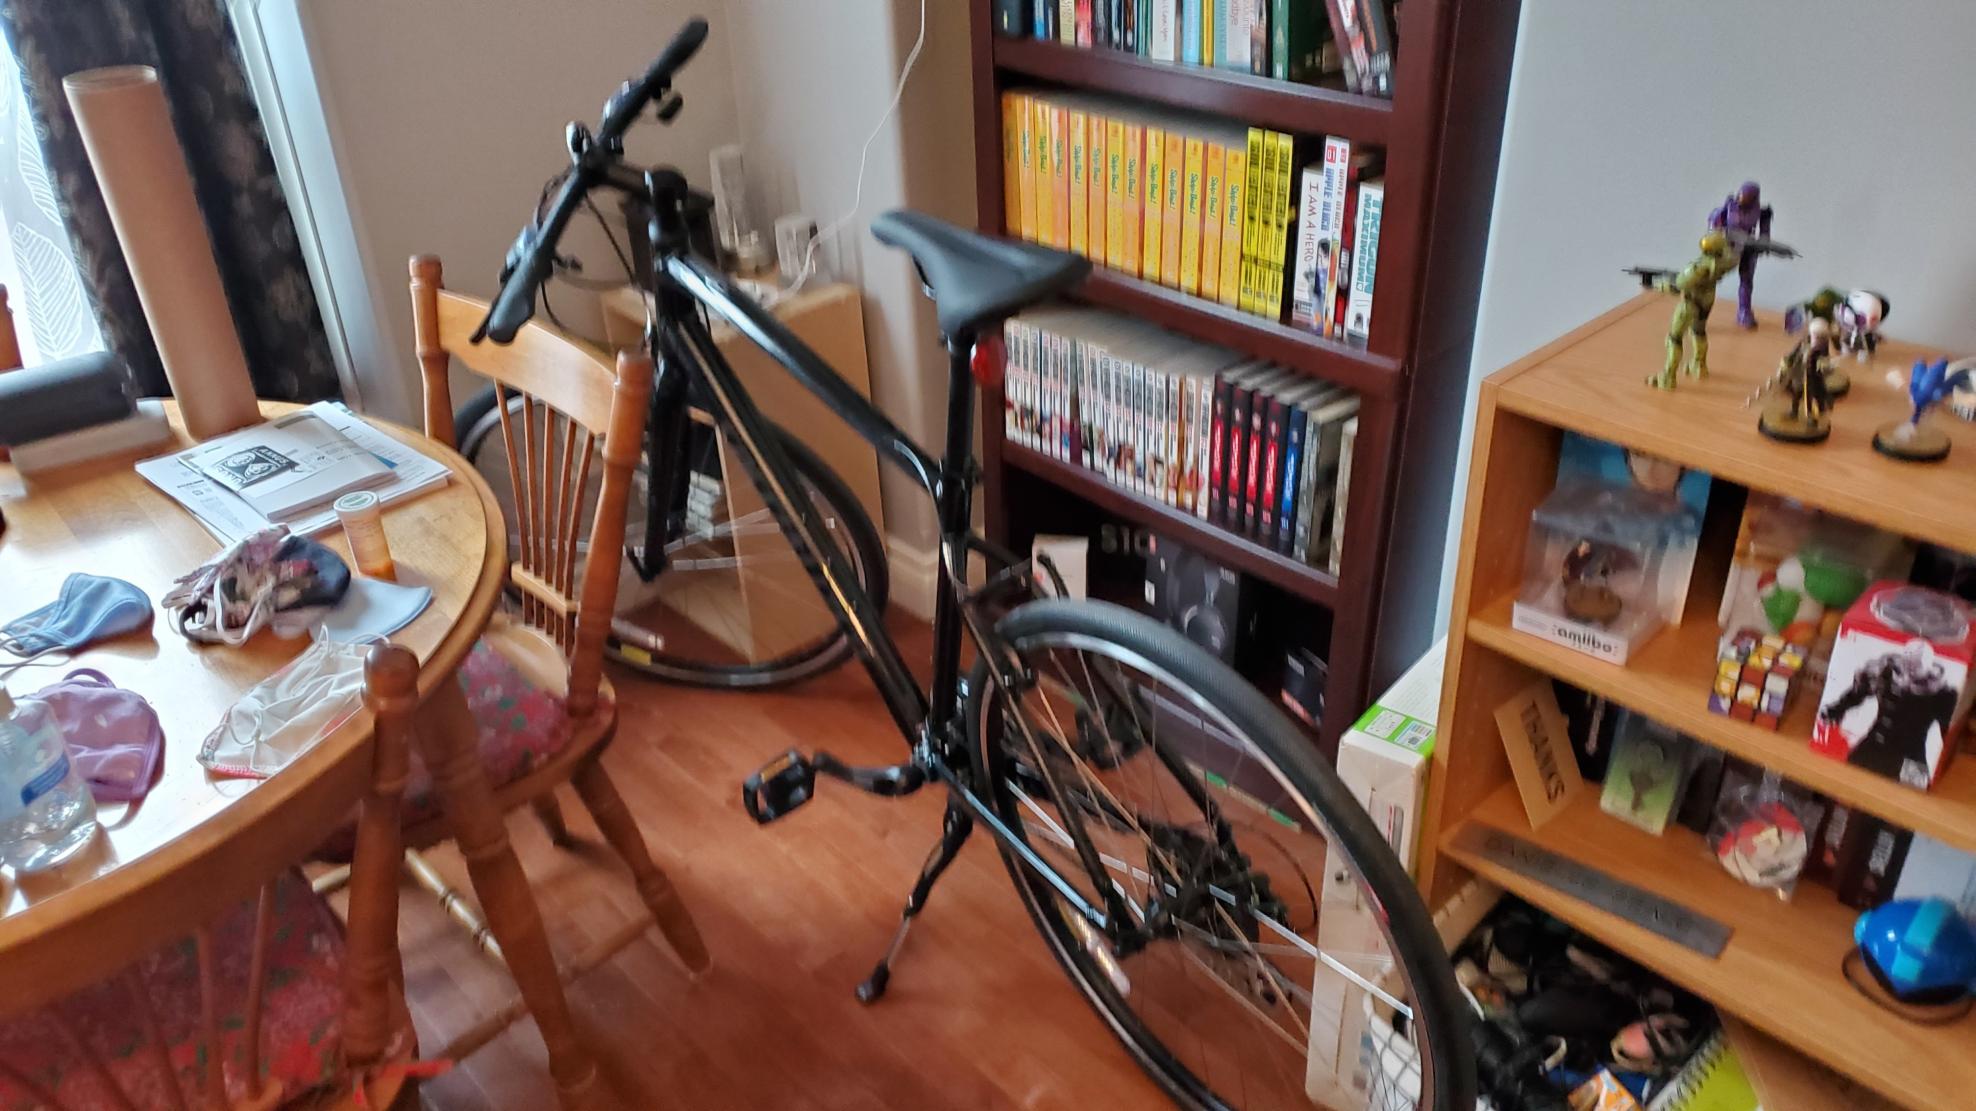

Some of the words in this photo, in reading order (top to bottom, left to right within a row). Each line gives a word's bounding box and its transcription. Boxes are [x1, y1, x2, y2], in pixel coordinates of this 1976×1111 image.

[1307, 194, 1318, 217] AM
[1304, 233, 1316, 262] HERO
[1357, 193, 1373, 282] MAXIMUM
[1557, 627, 1612, 653] amiibo
[1521, 699, 1566, 804] THANKS
